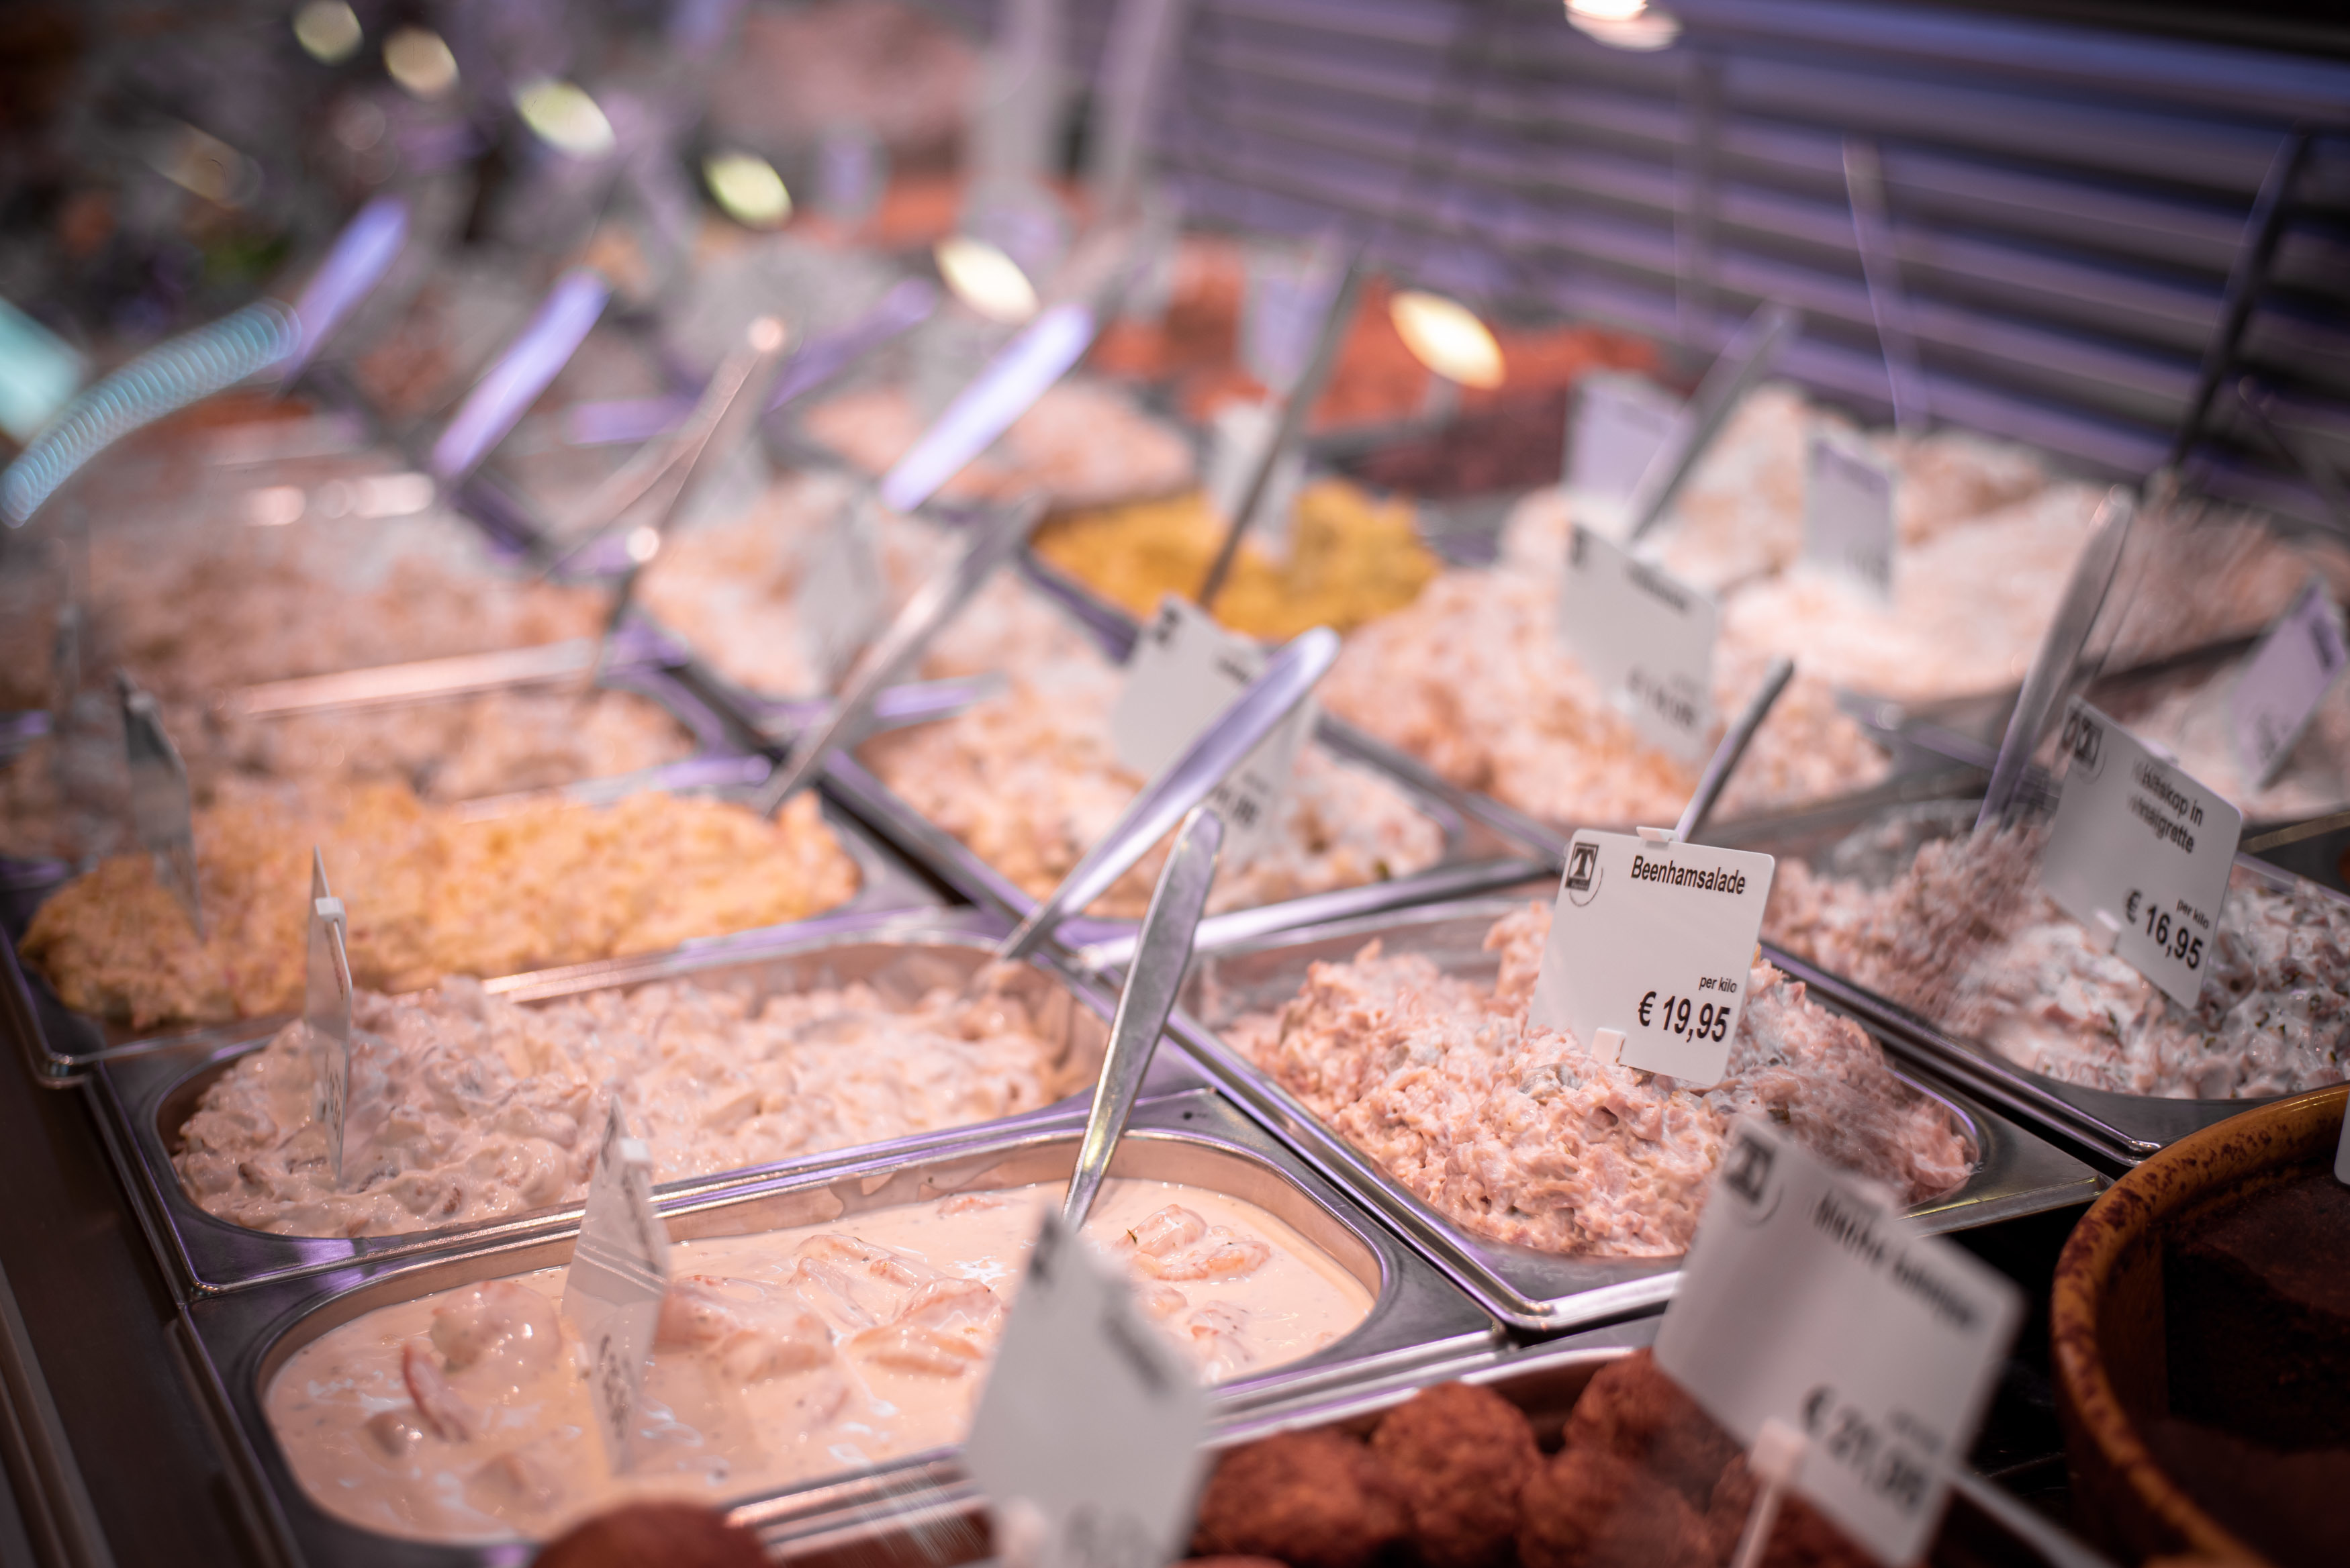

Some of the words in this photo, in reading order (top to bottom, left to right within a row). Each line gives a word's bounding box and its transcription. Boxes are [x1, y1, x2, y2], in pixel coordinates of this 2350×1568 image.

[2131, 758, 2188, 819] skop
[2190, 799, 2204, 827] in
[2128, 792, 2194, 854] naigrette
[1631, 854, 1746, 895] Beenhamsalade
[2125, 890, 2142, 925] €
[2146, 903, 2204, 971] 16,95
[2177, 899, 2192, 916] per
[2192, 908, 2209, 930] kilo
[1698, 977, 1718, 991] per
[1718, 977, 1738, 993] kilo
[1638, 991, 1657, 1027] €
[1663, 995, 1731, 1043] 19,95
